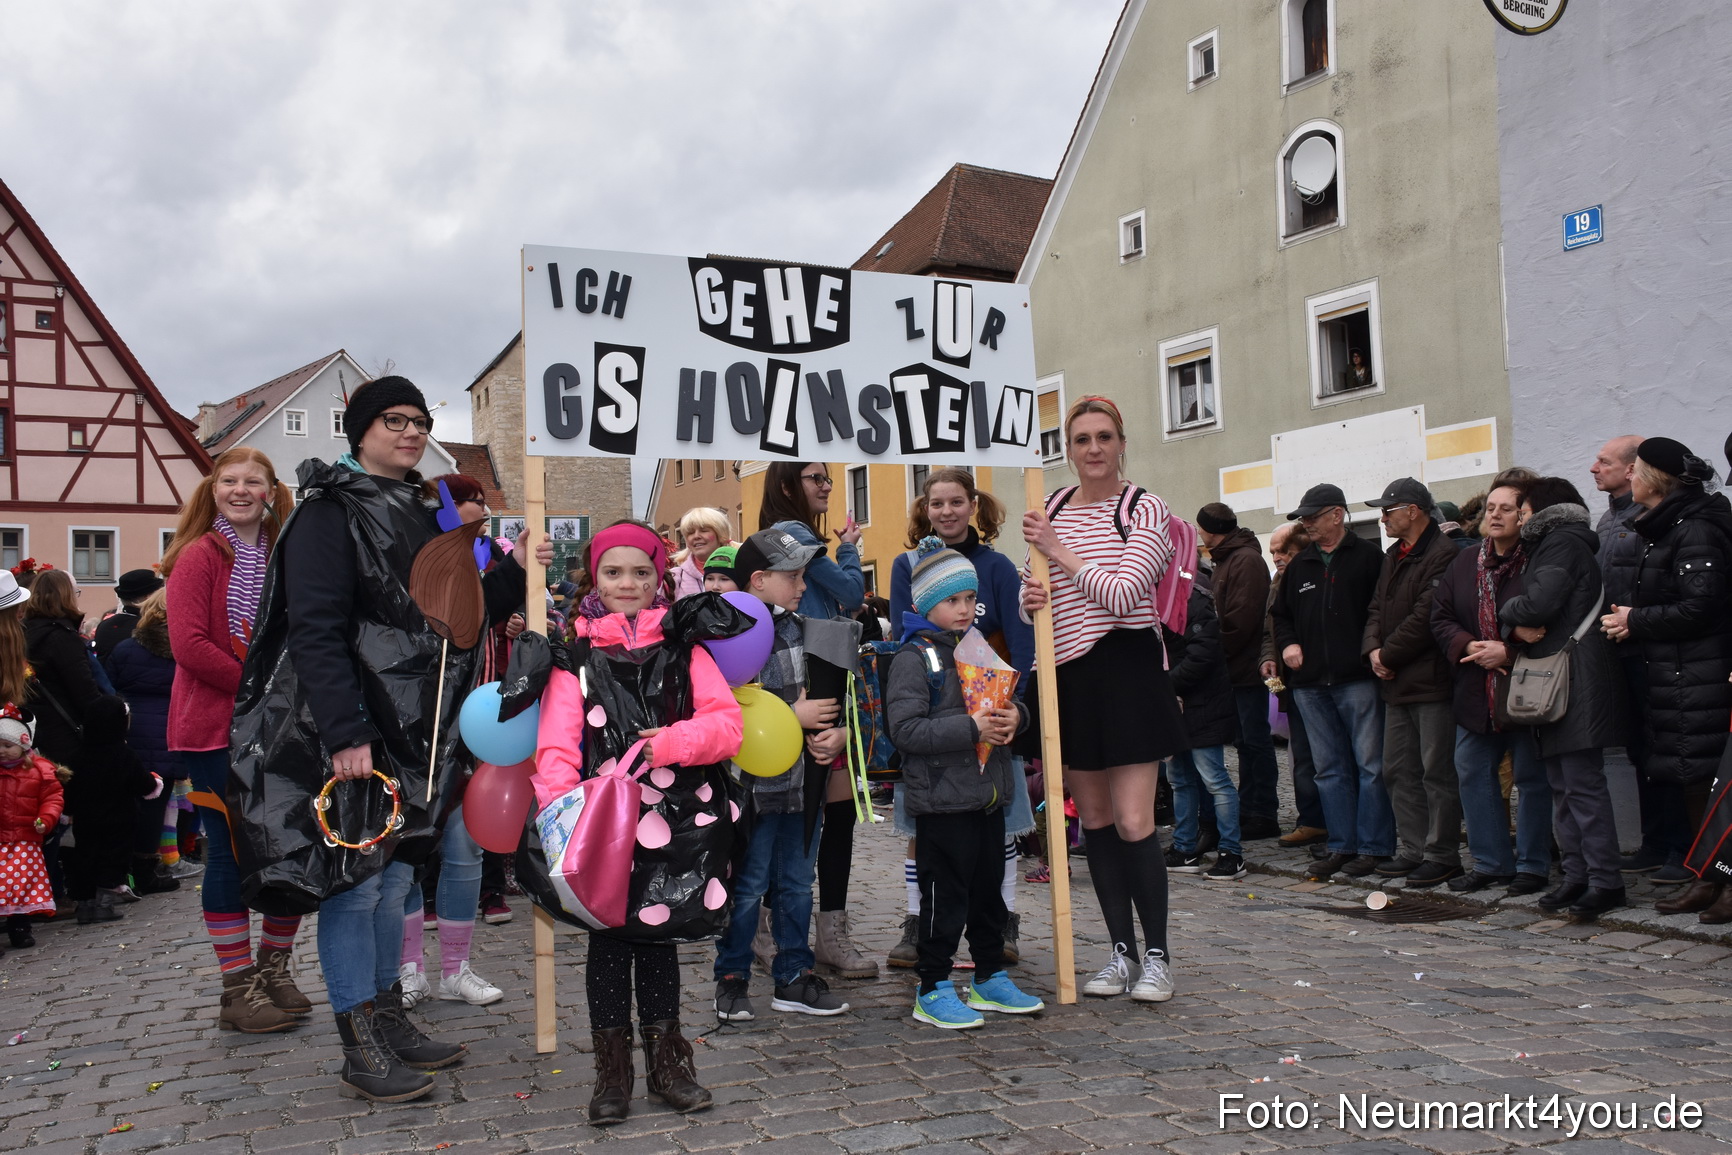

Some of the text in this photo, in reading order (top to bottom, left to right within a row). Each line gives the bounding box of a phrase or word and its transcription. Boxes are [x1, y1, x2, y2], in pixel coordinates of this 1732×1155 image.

[1503, 0, 1545, 19] BERCHING
[1573, 212, 1590, 232] 19
[547, 262, 1006, 359] ICH GEHE ZUR
[543, 351, 1033, 455] GS HOLNSTEIN
